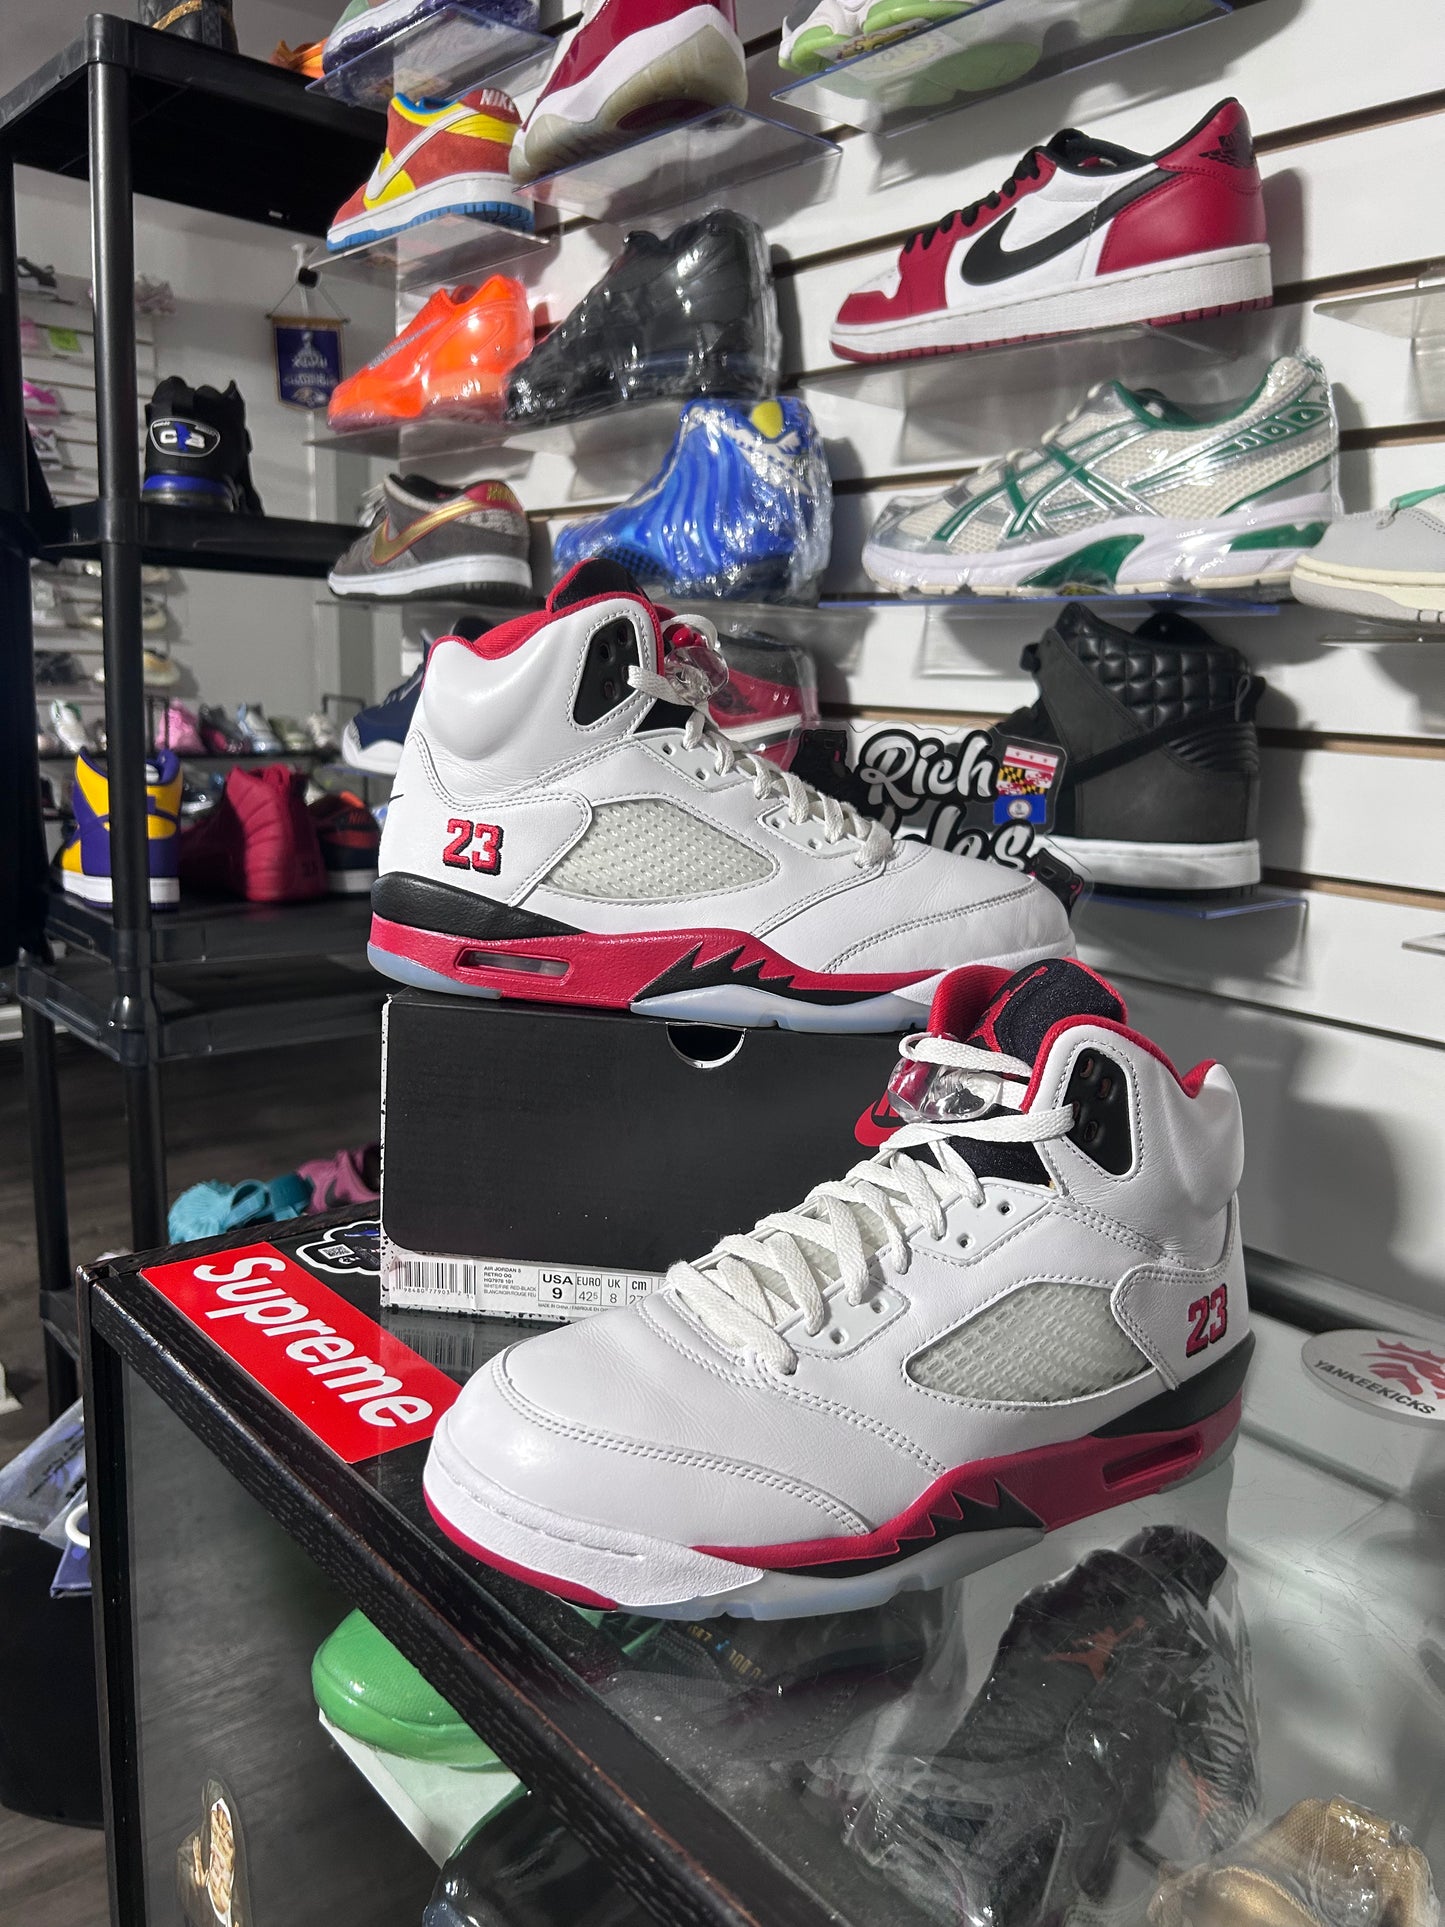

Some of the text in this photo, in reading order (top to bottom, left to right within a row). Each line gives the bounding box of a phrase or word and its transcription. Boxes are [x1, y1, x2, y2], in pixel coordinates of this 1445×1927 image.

[858, 732, 995, 811] Rich
[442, 818, 504, 876] 23
[542, 1273, 647, 1291] USA EURO UK cm
[552, 1287, 563, 1300] 9
[609, 1293, 618, 1304] 8
[193, 1256, 433, 1427] Supreme
[1186, 1283, 1227, 1358] 23
[1314, 1360, 1436, 1414] YANKEEKICKS
